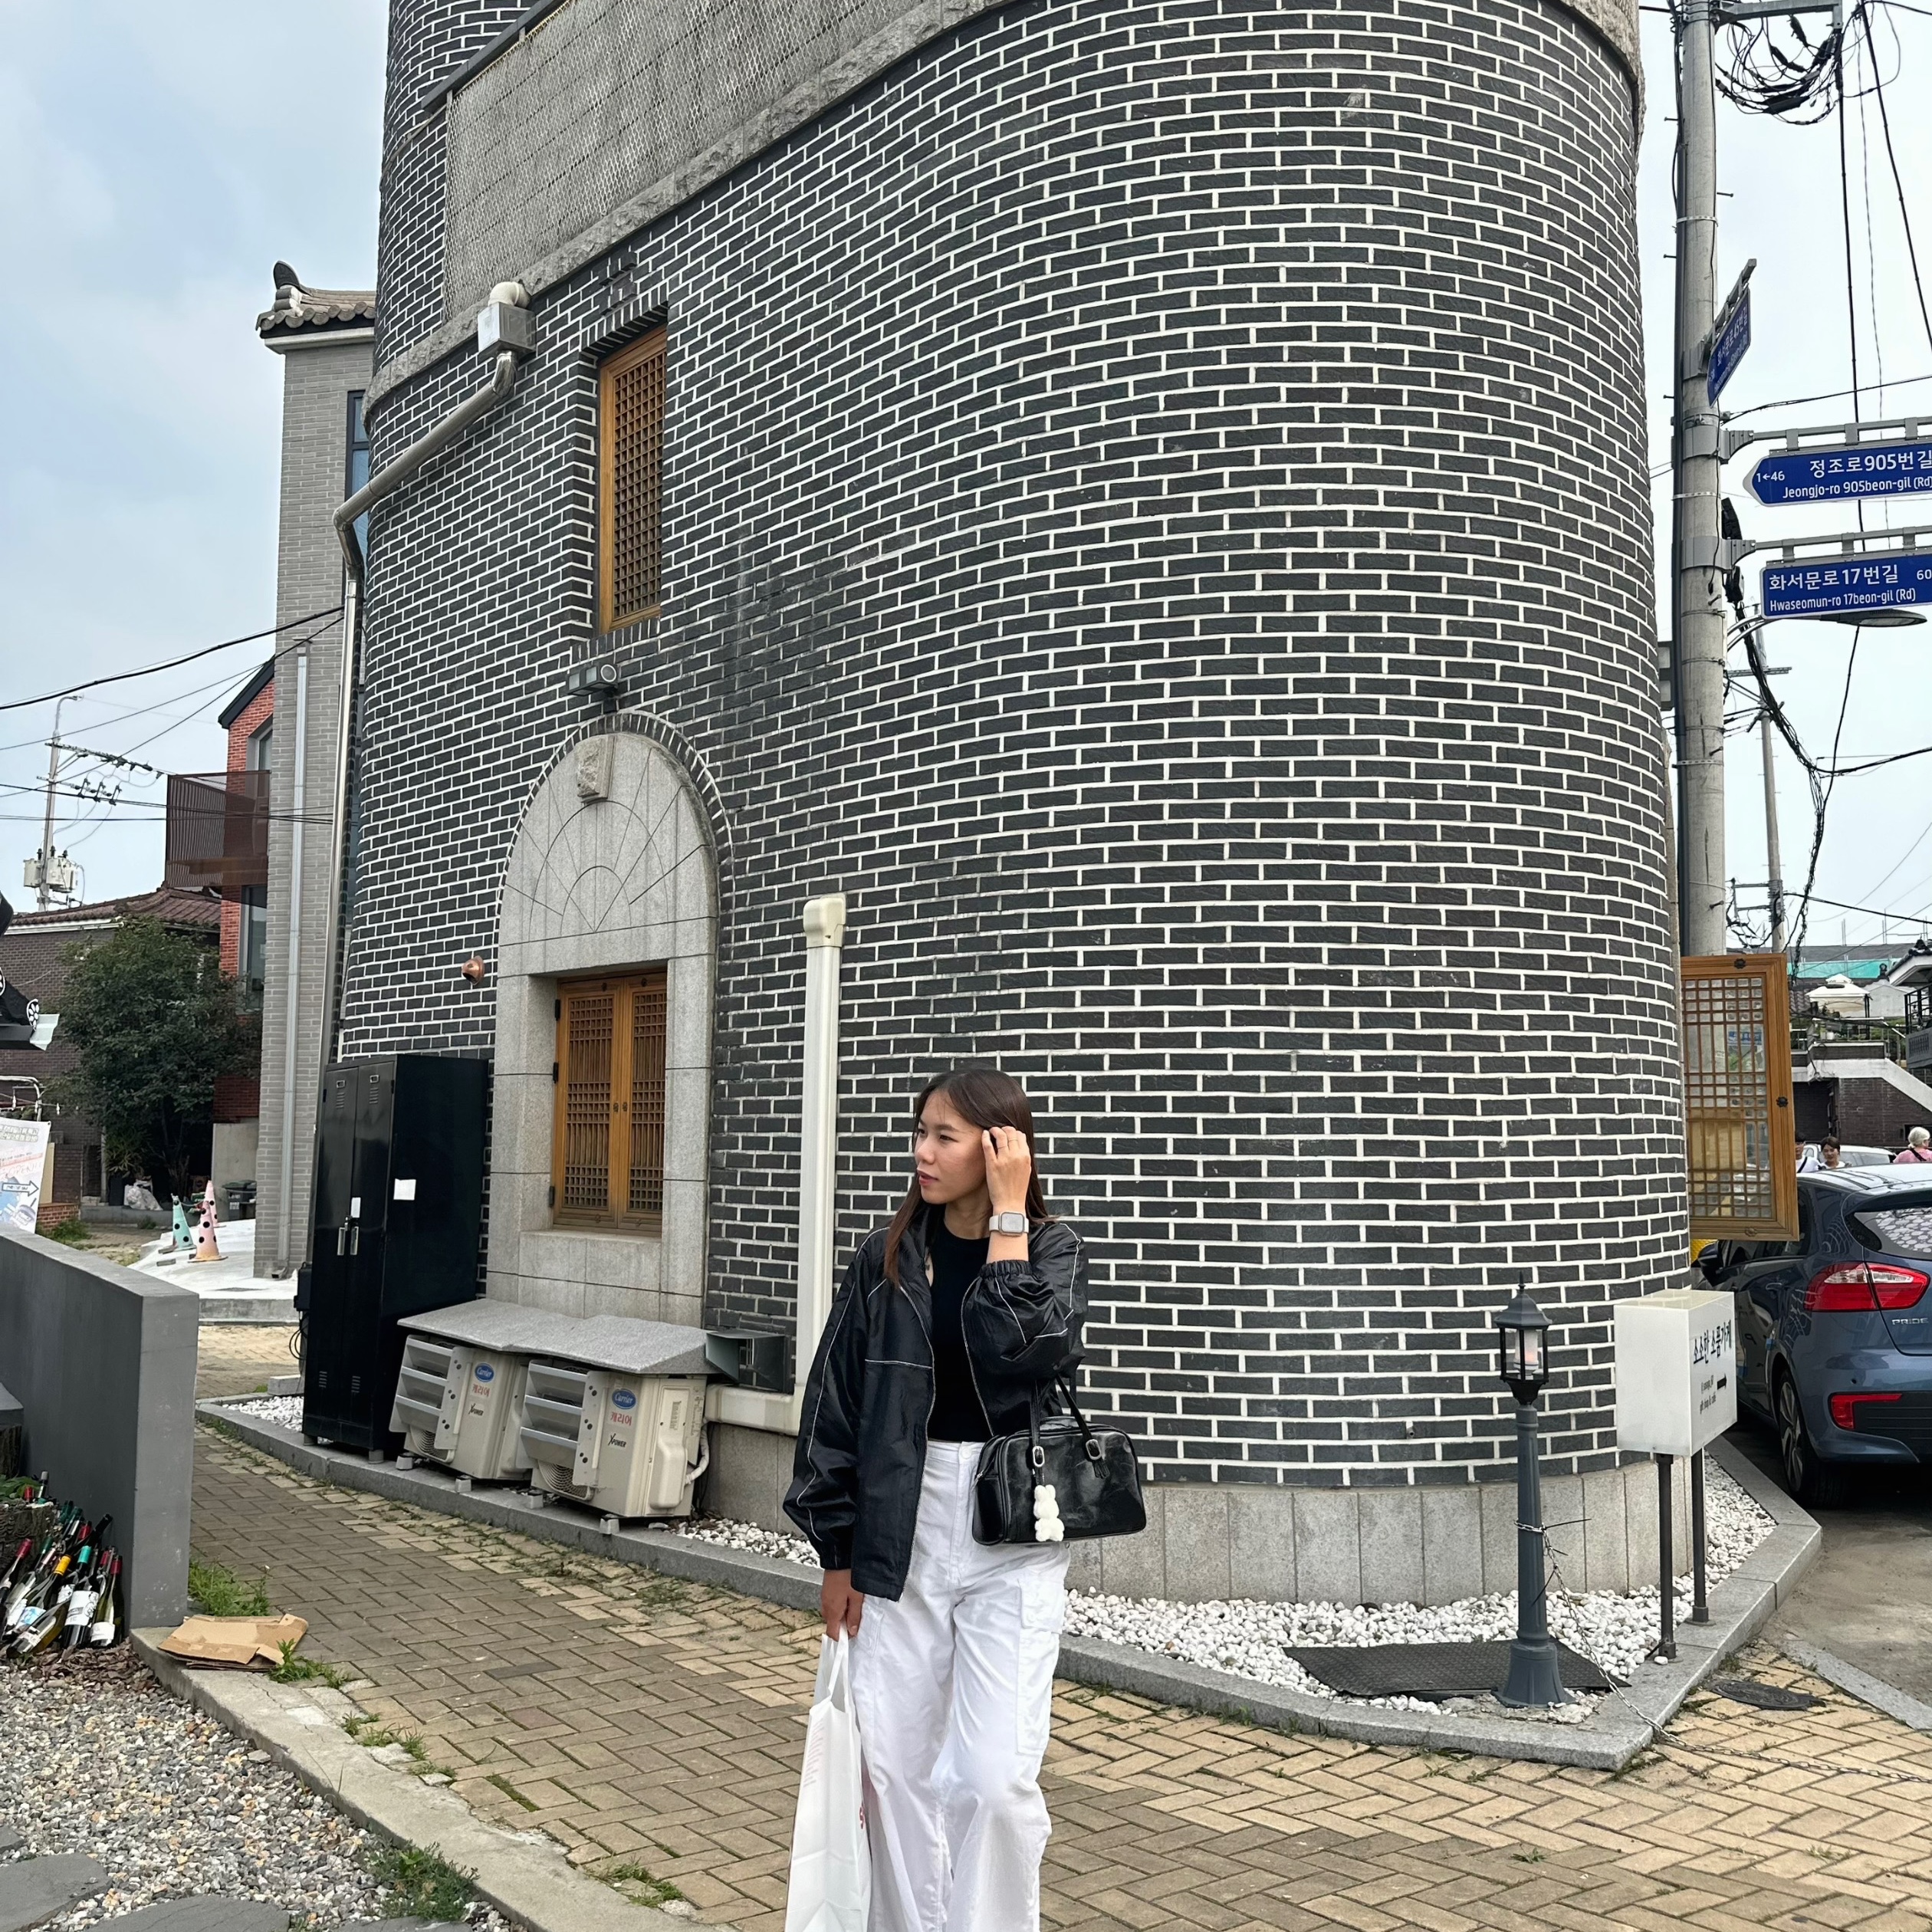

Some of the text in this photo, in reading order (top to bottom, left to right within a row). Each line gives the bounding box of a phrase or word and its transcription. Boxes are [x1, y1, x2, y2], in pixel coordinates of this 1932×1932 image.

[1810, 450, 1932, 478] 정조로905번길
[1783, 485, 1840, 498] Jeongjo-ro
[1843, 476, 1911, 493] 905beon-gil
[1769, 564, 1898, 590] 화서문로17번길
[1917, 569, 1932, 580] 60
[1770, 588, 1916, 612] Hwaseomun-ro 17beon-gil (Rd)
[1891, 1317, 1929, 1326] PRIDE
[1693, 1319, 1732, 1364] 소소한 소품가게
[476, 1366, 492, 1378] Carrier
[615, 1392, 633, 1404] Carrier
[610, 1411, 632, 1426] 캐리어
